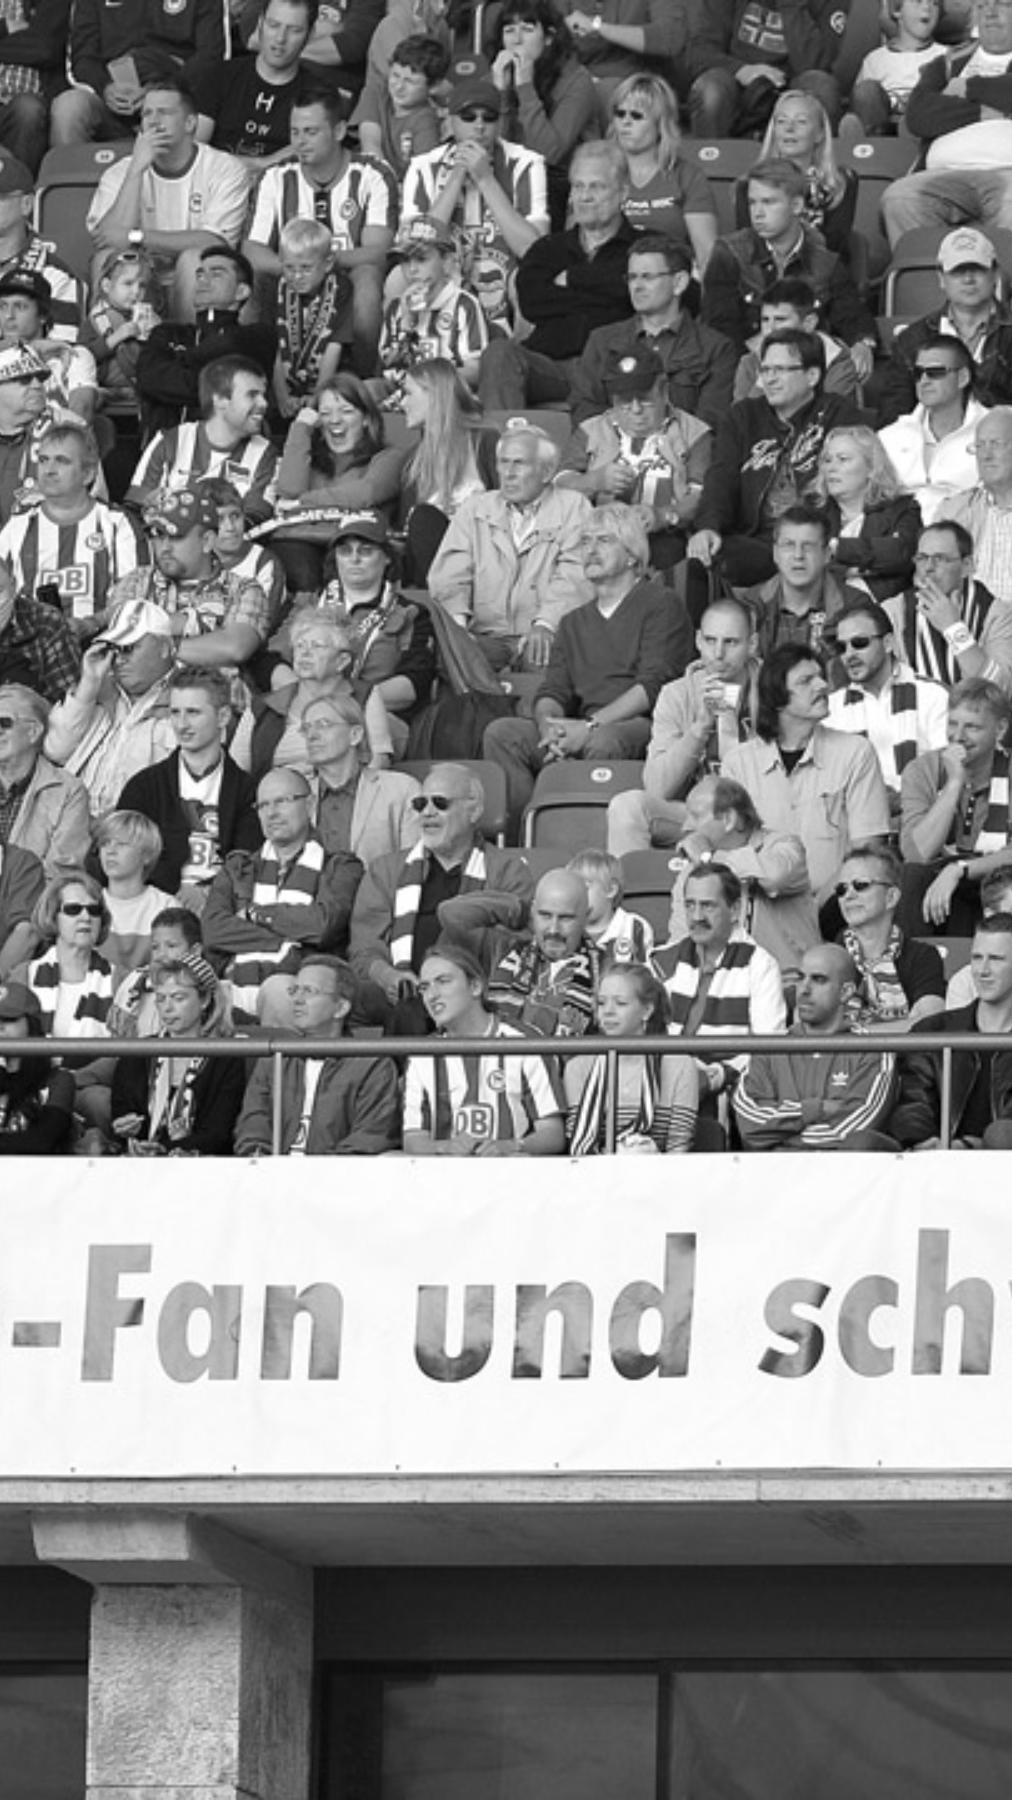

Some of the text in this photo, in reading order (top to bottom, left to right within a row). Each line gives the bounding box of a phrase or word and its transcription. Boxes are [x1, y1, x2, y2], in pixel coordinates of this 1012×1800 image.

[11, 1228, 1012, 1383] -Fan und sch
